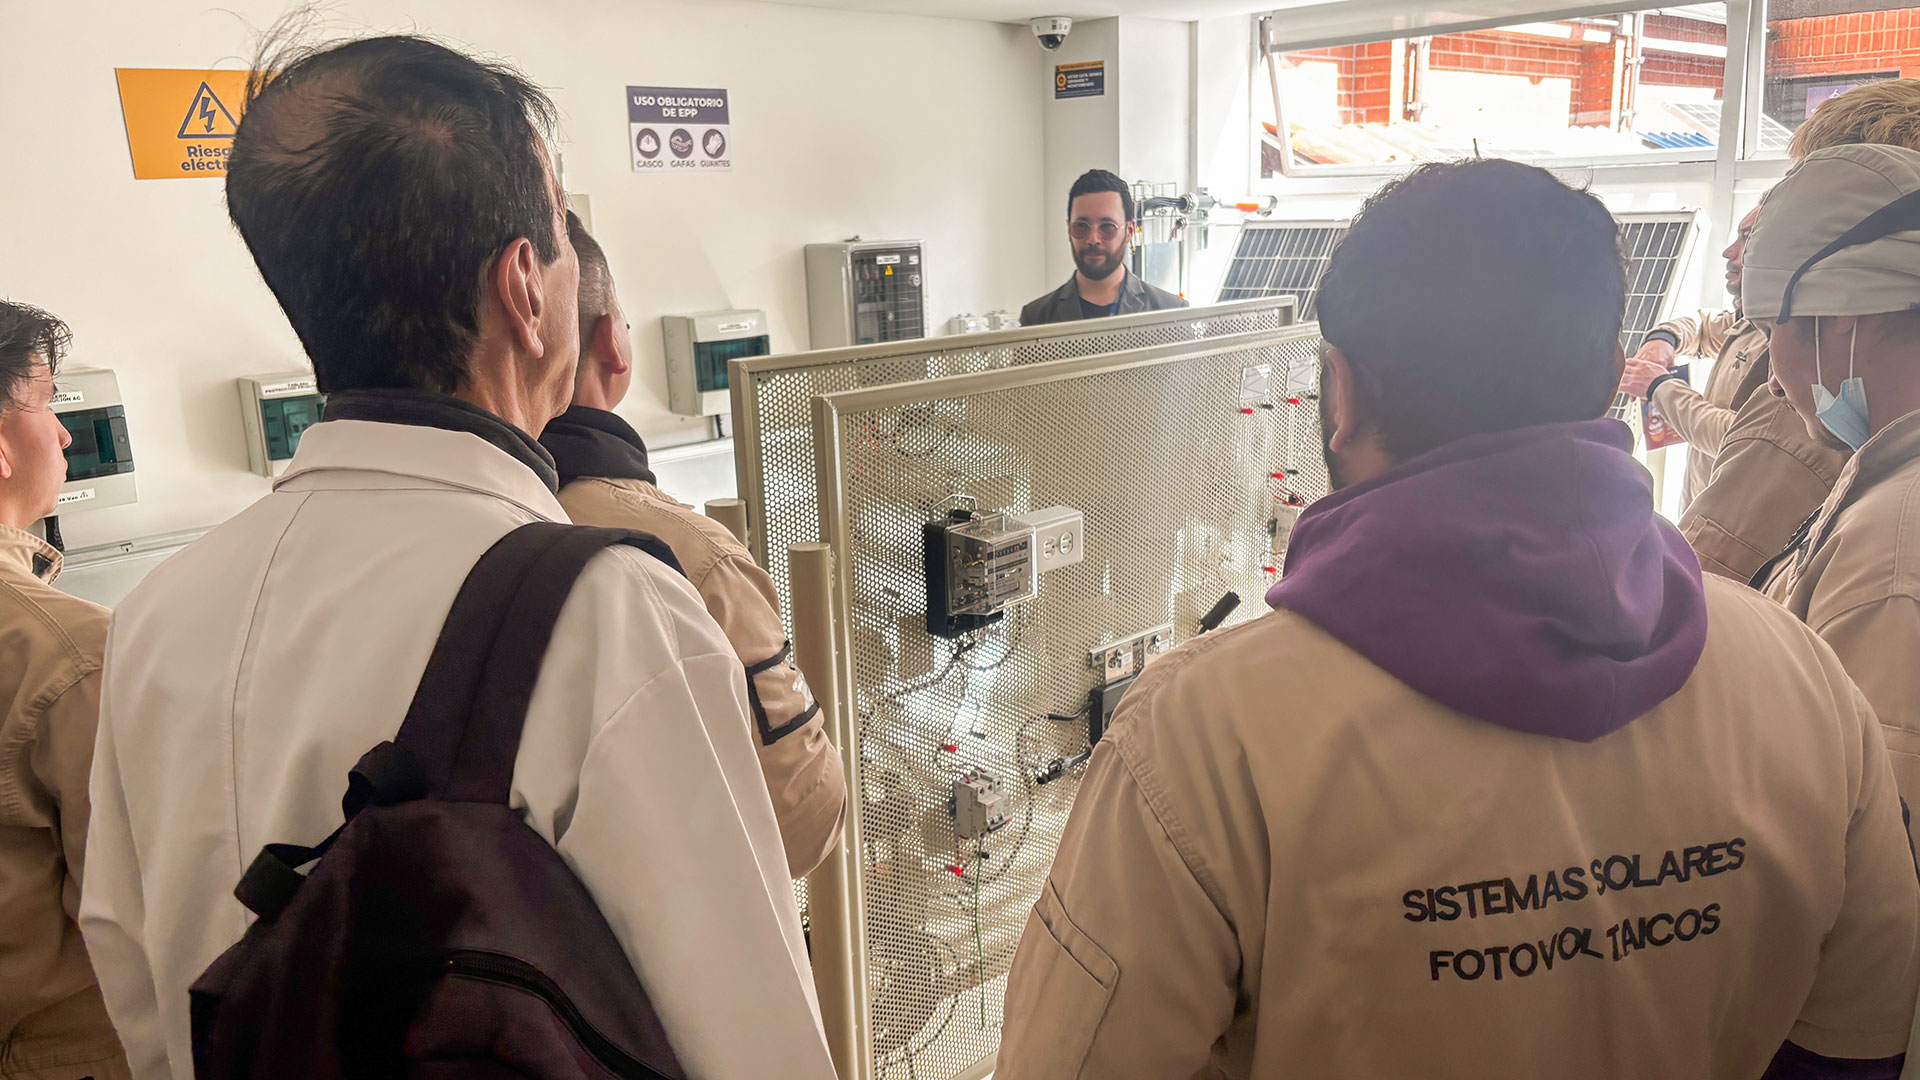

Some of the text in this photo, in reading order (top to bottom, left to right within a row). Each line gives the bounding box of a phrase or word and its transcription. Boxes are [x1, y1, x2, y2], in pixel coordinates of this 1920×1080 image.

[633, 96, 724, 108] USO OBLIGATORIO
[662, 107, 698, 118] DE EPP
[186, 144, 233, 159] Riesg
[636, 160, 664, 168] CASCO
[670, 160, 696, 168] GAFAS
[700, 160, 731, 168] GUANTES
[1402, 837, 1746, 922] SISTEMAS SOLARES
